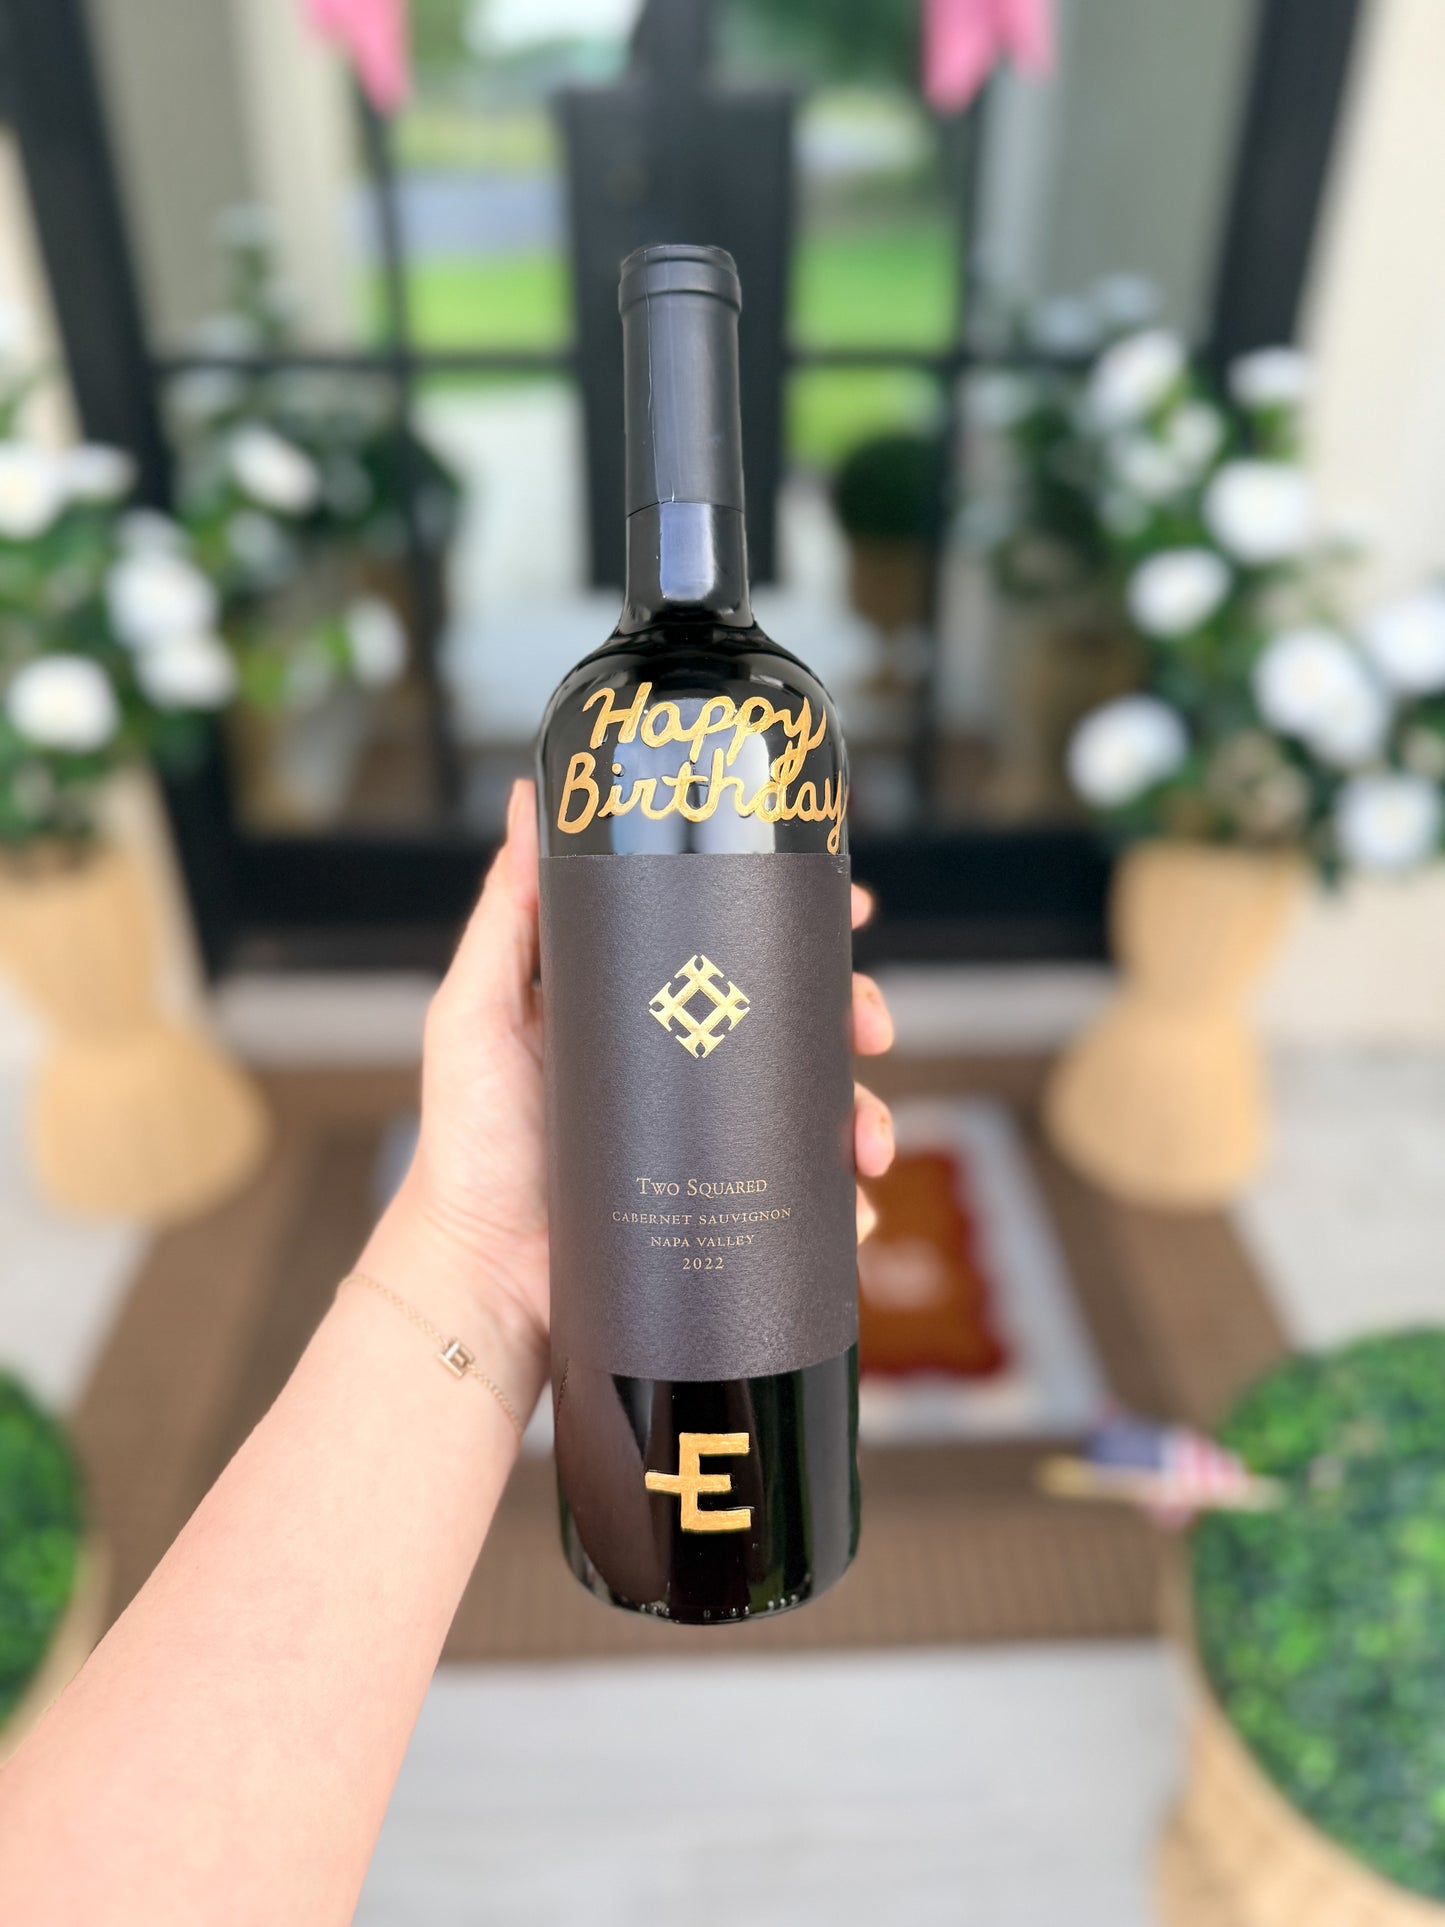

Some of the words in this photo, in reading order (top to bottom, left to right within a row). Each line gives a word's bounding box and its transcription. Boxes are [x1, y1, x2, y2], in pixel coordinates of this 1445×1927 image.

[582, 682, 827, 786] Happy
[557, 743, 848, 855] Birthday
[612, 1210, 692, 1226] CABERNET
[699, 1207, 792, 1226] SAUVIGNON
[650, 1235, 690, 1248] NAPA
[696, 1233, 755, 1248] VALLEY
[682, 1256, 724, 1271] 2022
